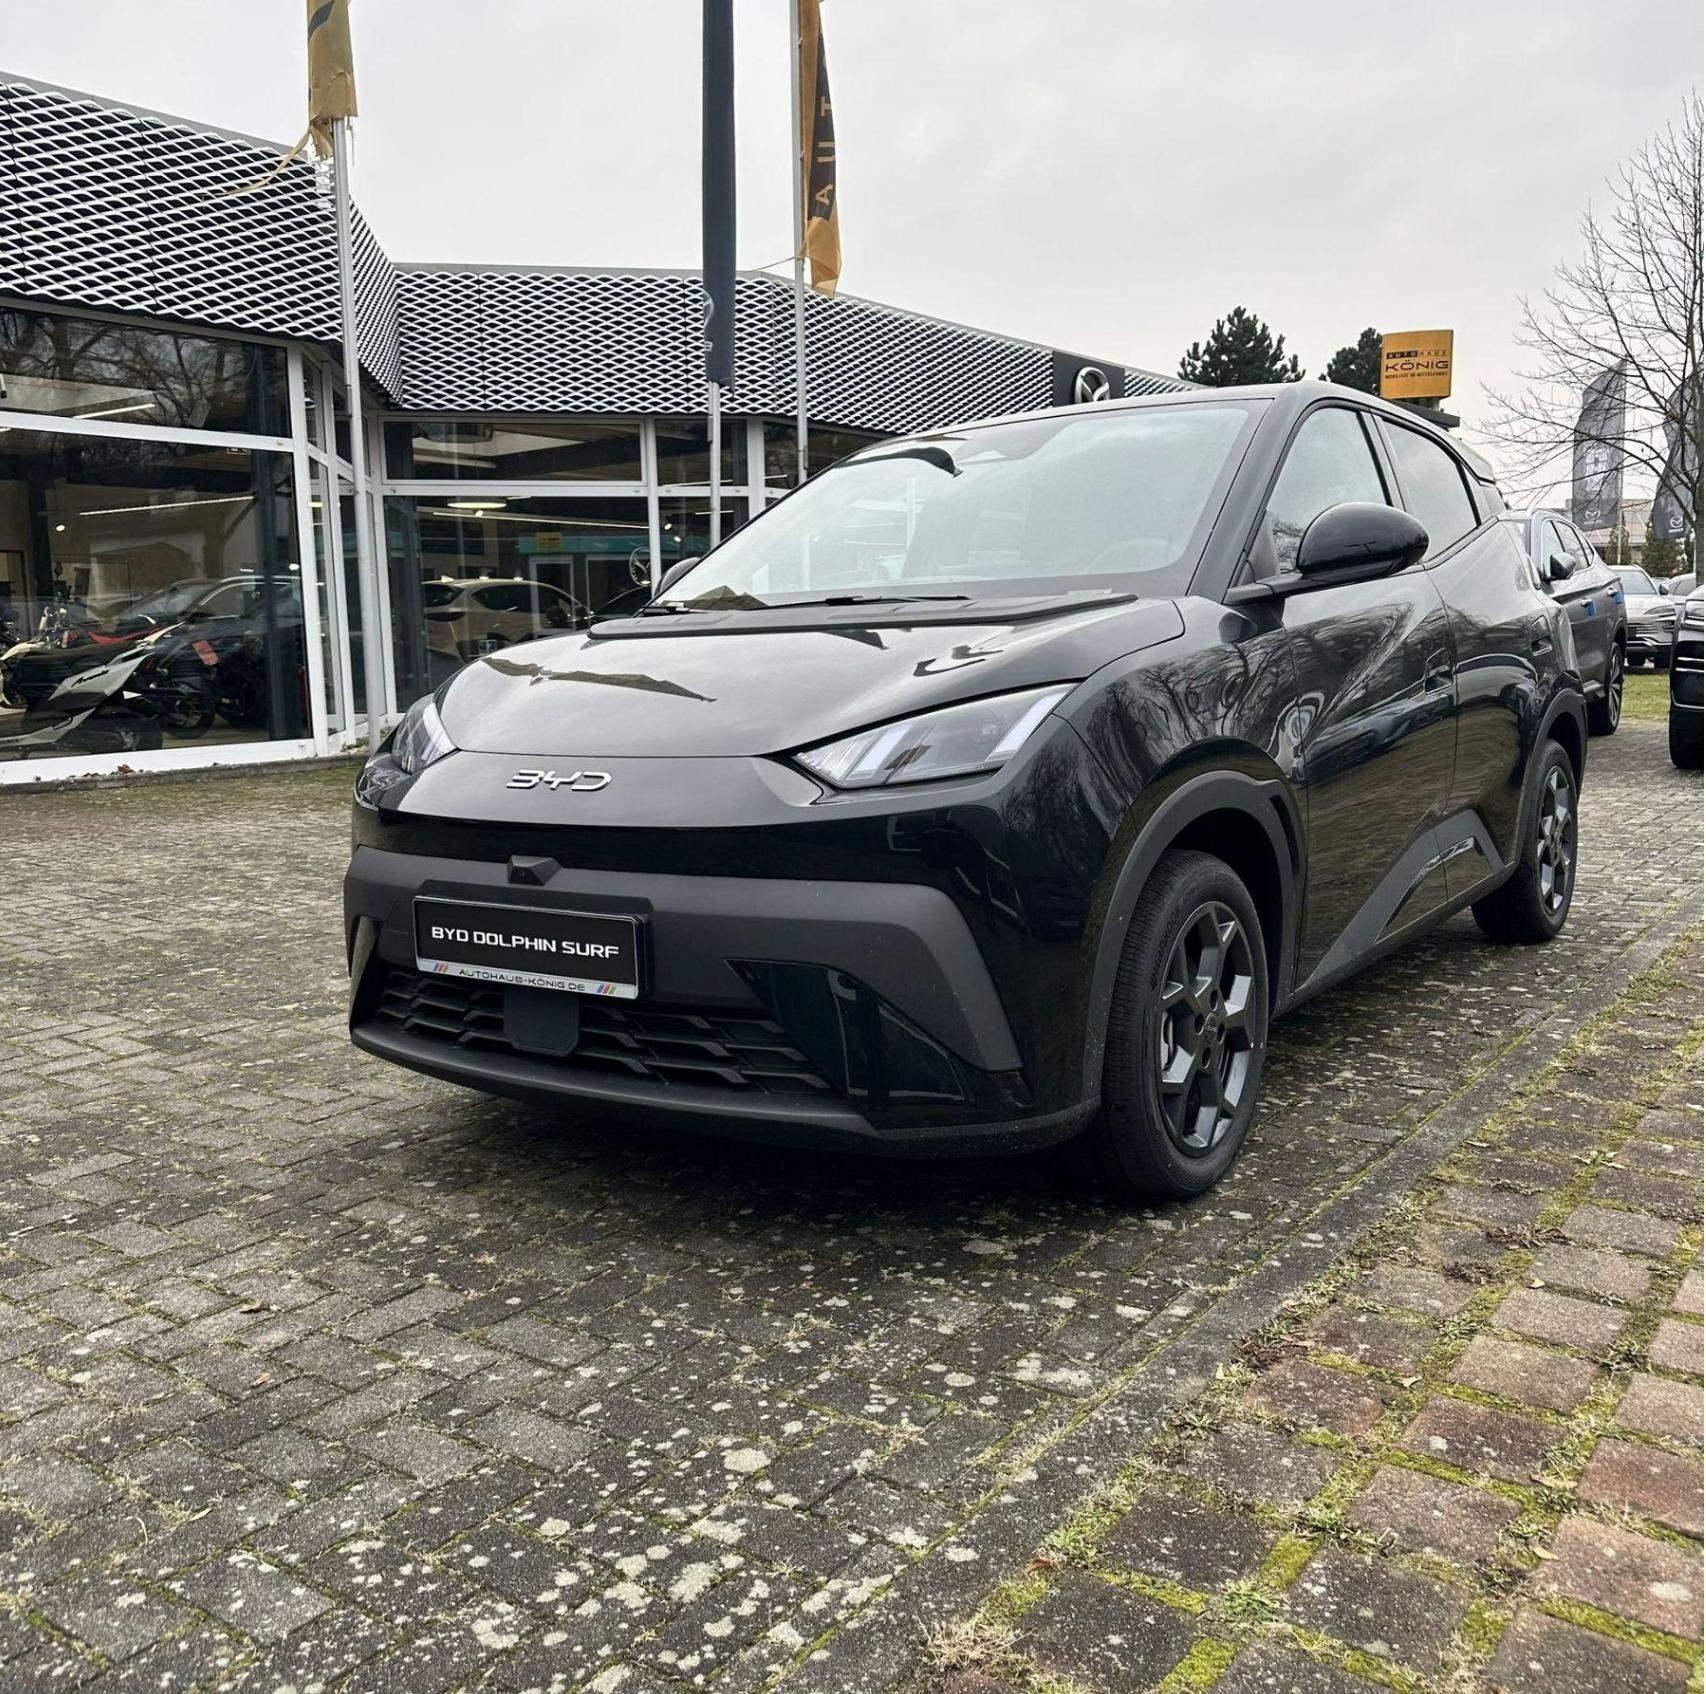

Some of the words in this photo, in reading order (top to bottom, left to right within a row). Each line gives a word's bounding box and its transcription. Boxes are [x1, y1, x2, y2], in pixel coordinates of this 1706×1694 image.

[1385, 359, 1449, 372] KÖNIG
[506, 769, 613, 792] BYD
[431, 926, 469, 943] BYD
[473, 931, 557, 953] DOLPHIN
[562, 942, 620, 959] SURF
